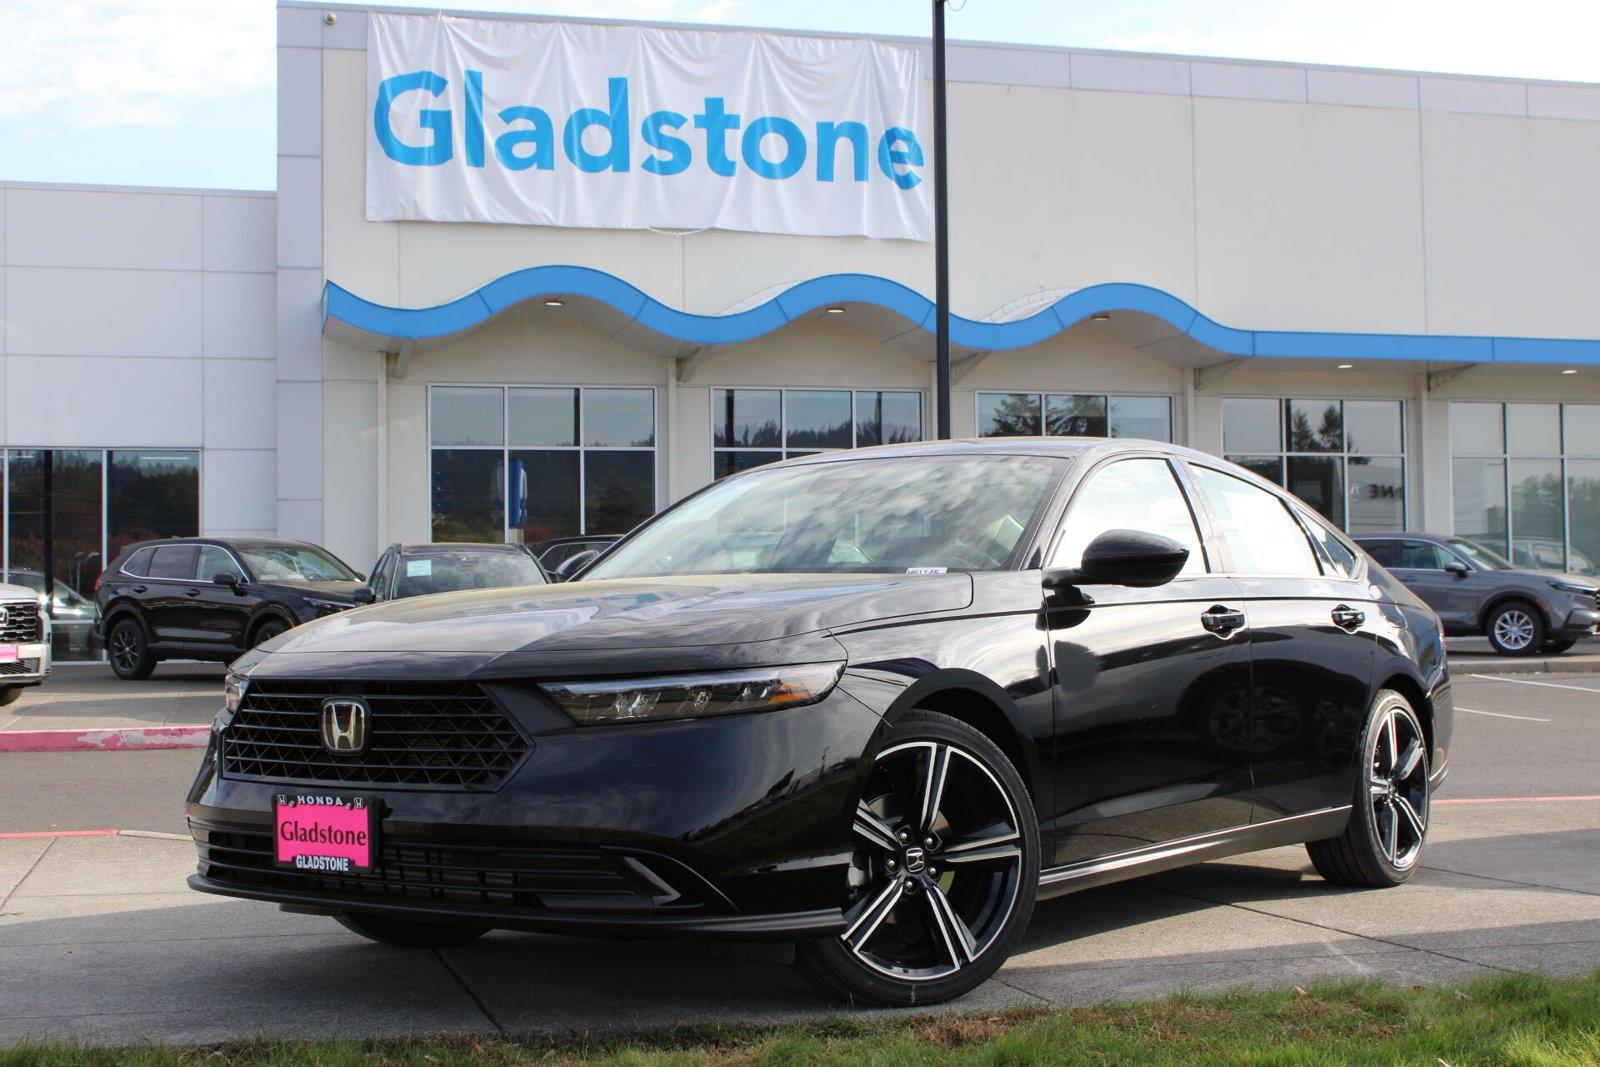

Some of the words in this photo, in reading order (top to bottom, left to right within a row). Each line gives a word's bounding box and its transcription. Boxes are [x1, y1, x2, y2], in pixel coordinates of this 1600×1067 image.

[374, 70, 924, 190] Gladstone
[297, 795, 343, 806] HONDA
[280, 821, 367, 846] Gladstone
[296, 855, 349, 872] GLADSTONE
